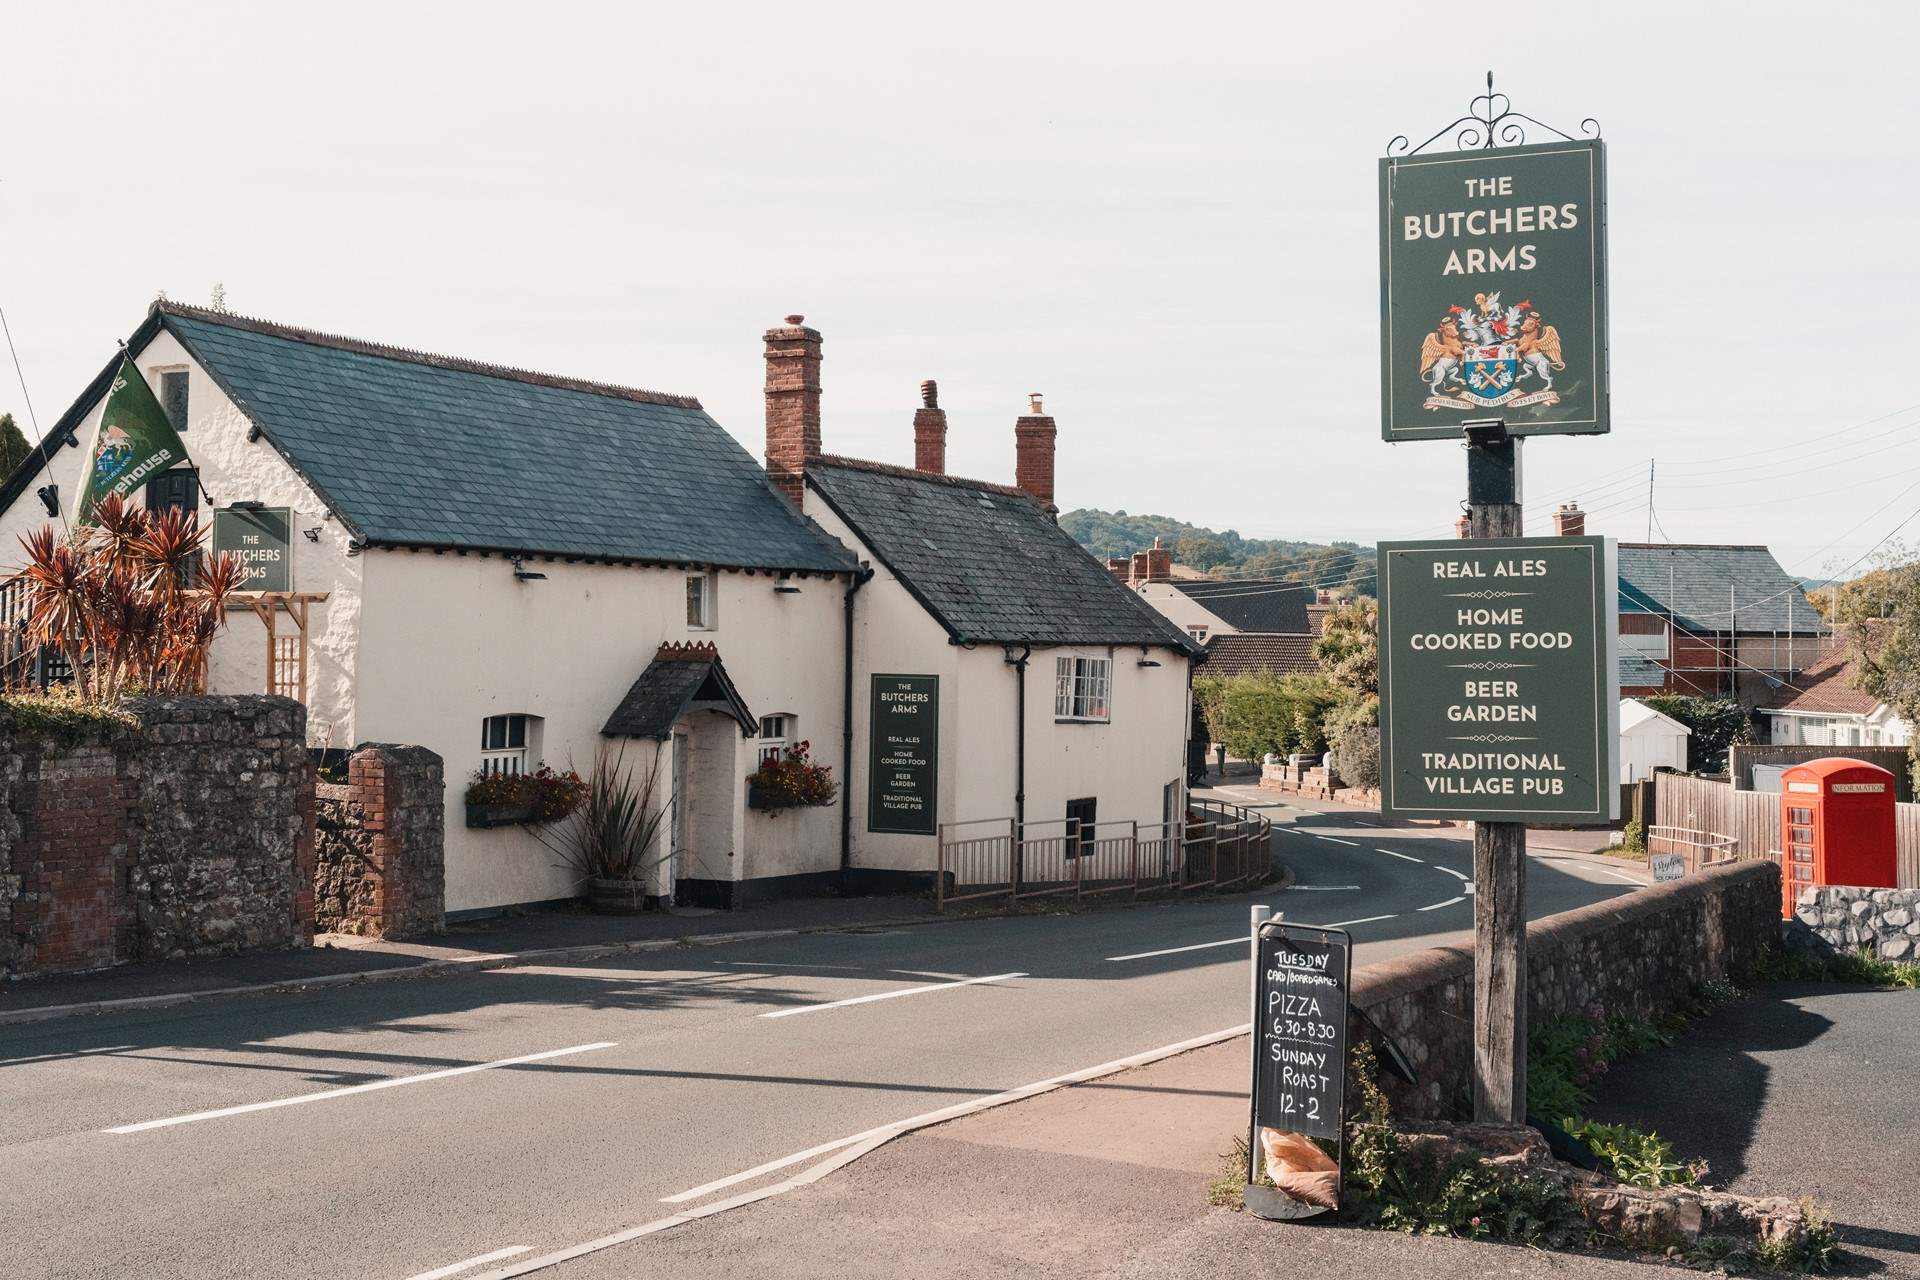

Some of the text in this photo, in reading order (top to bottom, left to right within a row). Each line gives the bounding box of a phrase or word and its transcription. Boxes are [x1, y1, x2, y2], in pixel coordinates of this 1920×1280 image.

[1464, 175, 1513, 198] THE
[1404, 203, 1578, 241] BUTCHERS
[1442, 245, 1537, 276] ARMS
[114, 448, 172, 494] ehouse
[242, 535, 260, 545] THE
[240, 566, 267, 579] RMS
[1433, 560, 1547, 578] REAL ALES
[1457, 608, 1523, 625] HOME
[1410, 632, 1572, 650] COOKED FOOD
[881, 693, 929, 702] BUTCHERS
[1465, 681, 1519, 698] BEER
[891, 705, 918, 714] ARMS
[1447, 705, 1537, 722] GARDEN
[1422, 753, 1565, 771] TRADITIONAL
[890, 780, 916, 788] GARDEN
[1424, 777, 1564, 795] VILLAGE PUB
[883, 794, 923, 803] TRADITIONAL
[883, 802, 909, 810] VILLAGE
[1274, 950, 1329, 969] TUESDAY
[1269, 991, 1321, 1017] PIZZA
[1271, 1043, 1326, 1069] SUNDAY
[1283, 1066, 1329, 1093] ROAST
